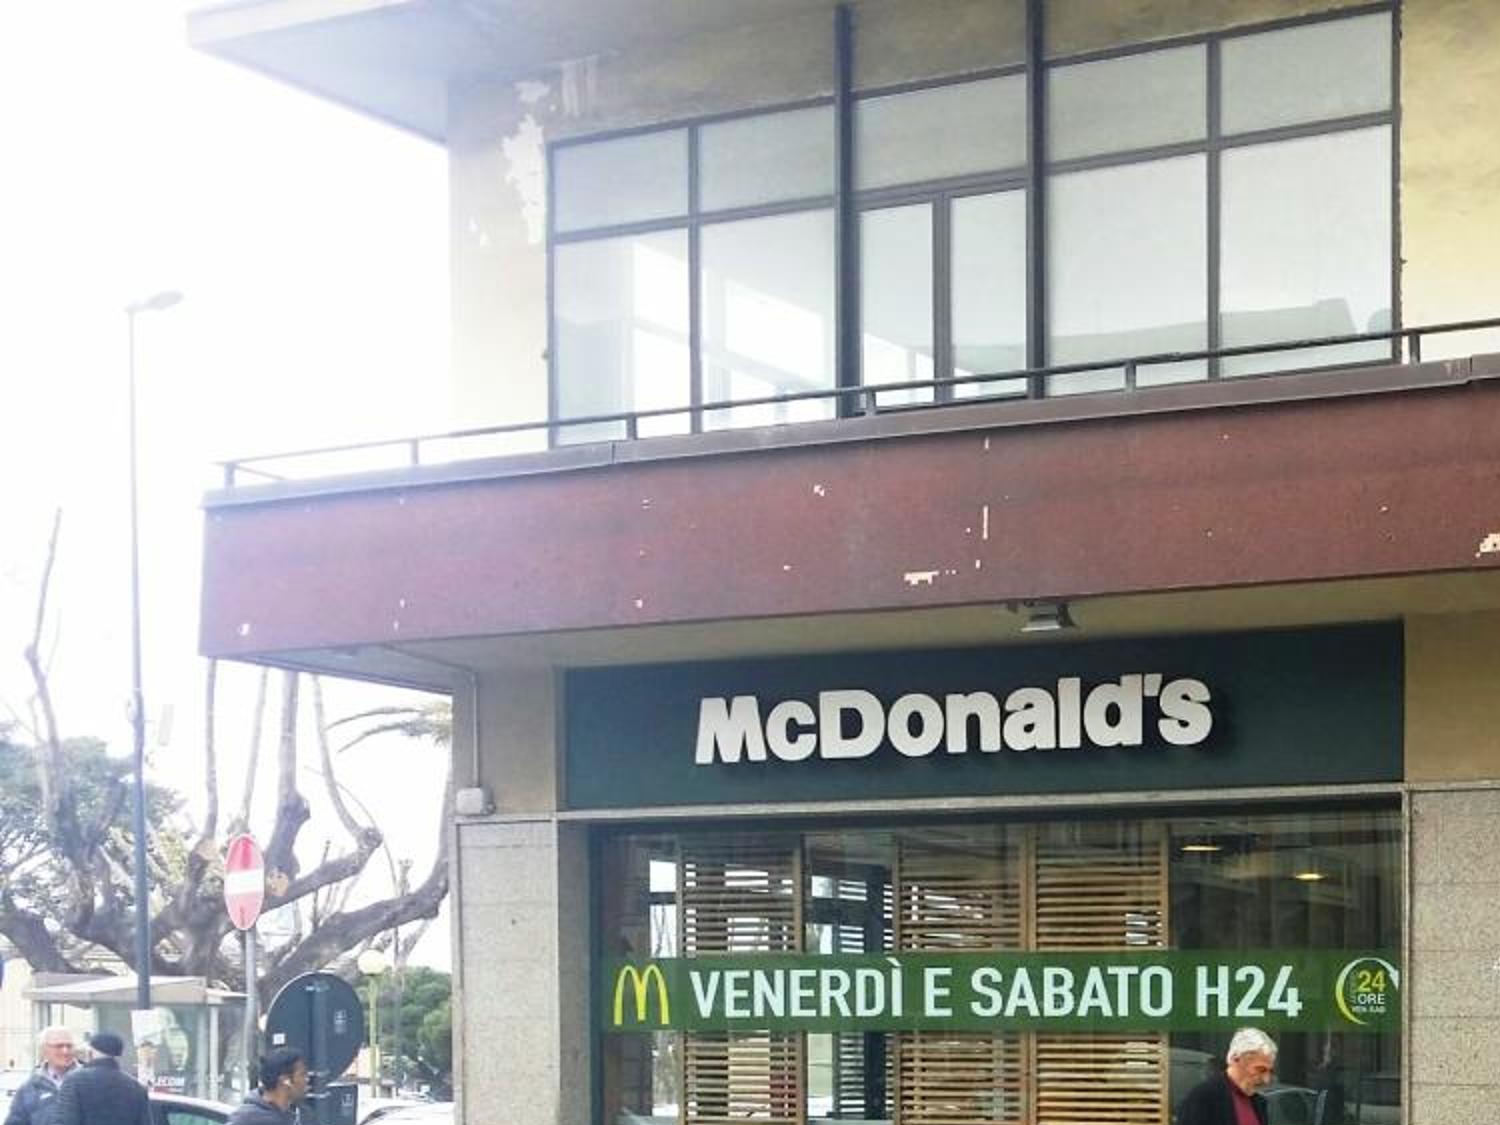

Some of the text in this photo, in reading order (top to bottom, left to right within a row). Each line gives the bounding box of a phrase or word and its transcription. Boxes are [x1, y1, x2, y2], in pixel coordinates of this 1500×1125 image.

[694, 672, 1213, 765] McDonald's
[689, 957, 903, 1019] VENERDÌ
[923, 967, 953, 1018] E
[970, 965, 1174, 1018] SABATO
[1195, 965, 1303, 1018] H24
[1357, 969, 1387, 993] 24
[1357, 993, 1386, 1005] ORE
